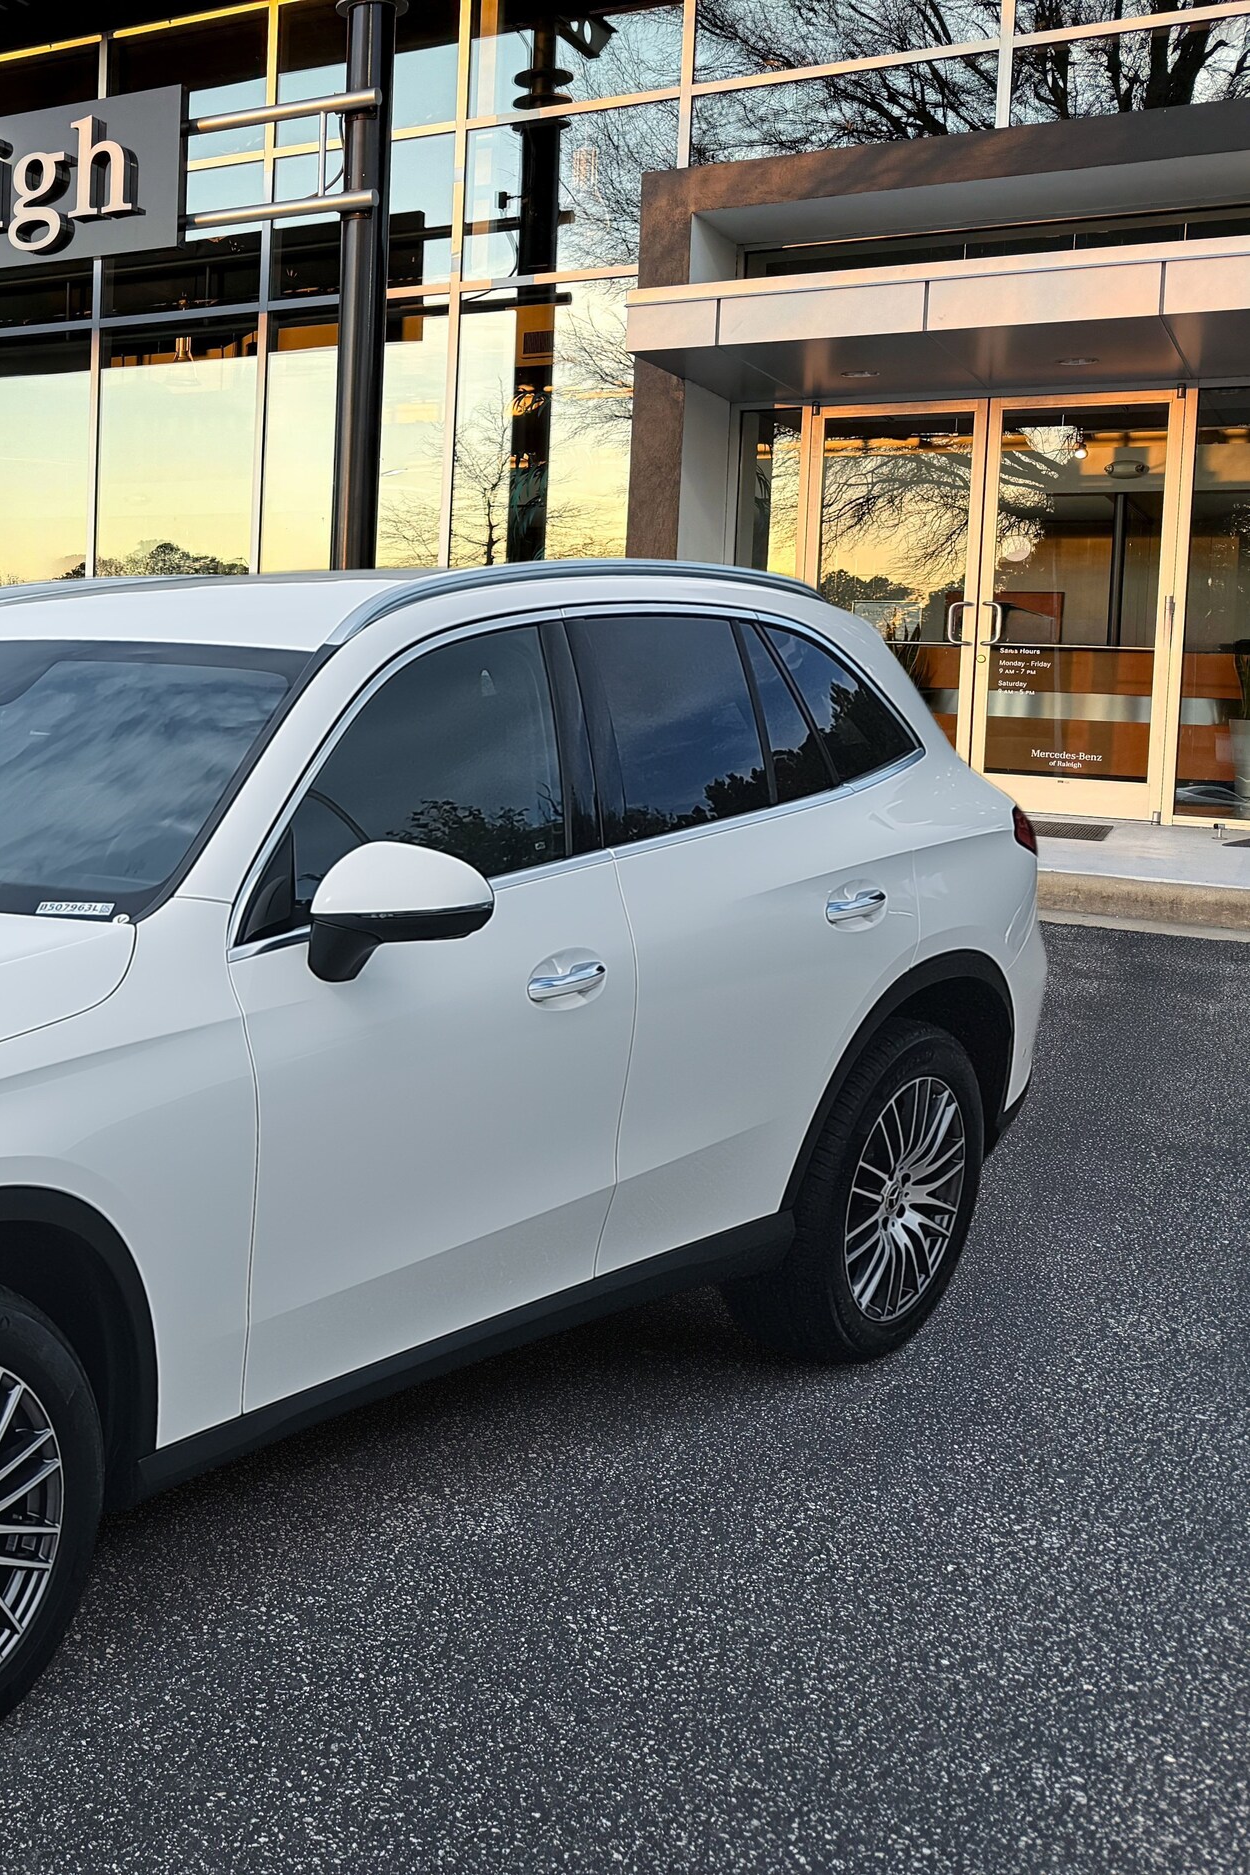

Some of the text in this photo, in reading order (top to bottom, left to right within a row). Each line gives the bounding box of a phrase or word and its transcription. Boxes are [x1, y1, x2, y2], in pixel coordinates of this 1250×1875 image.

[999, 660, 1025, 668] Monday
[1030, 661, 1052, 669] Friday
[997, 680, 1028, 688] Saturday
[1031, 749, 1103, 761] Mercedes-Benz
